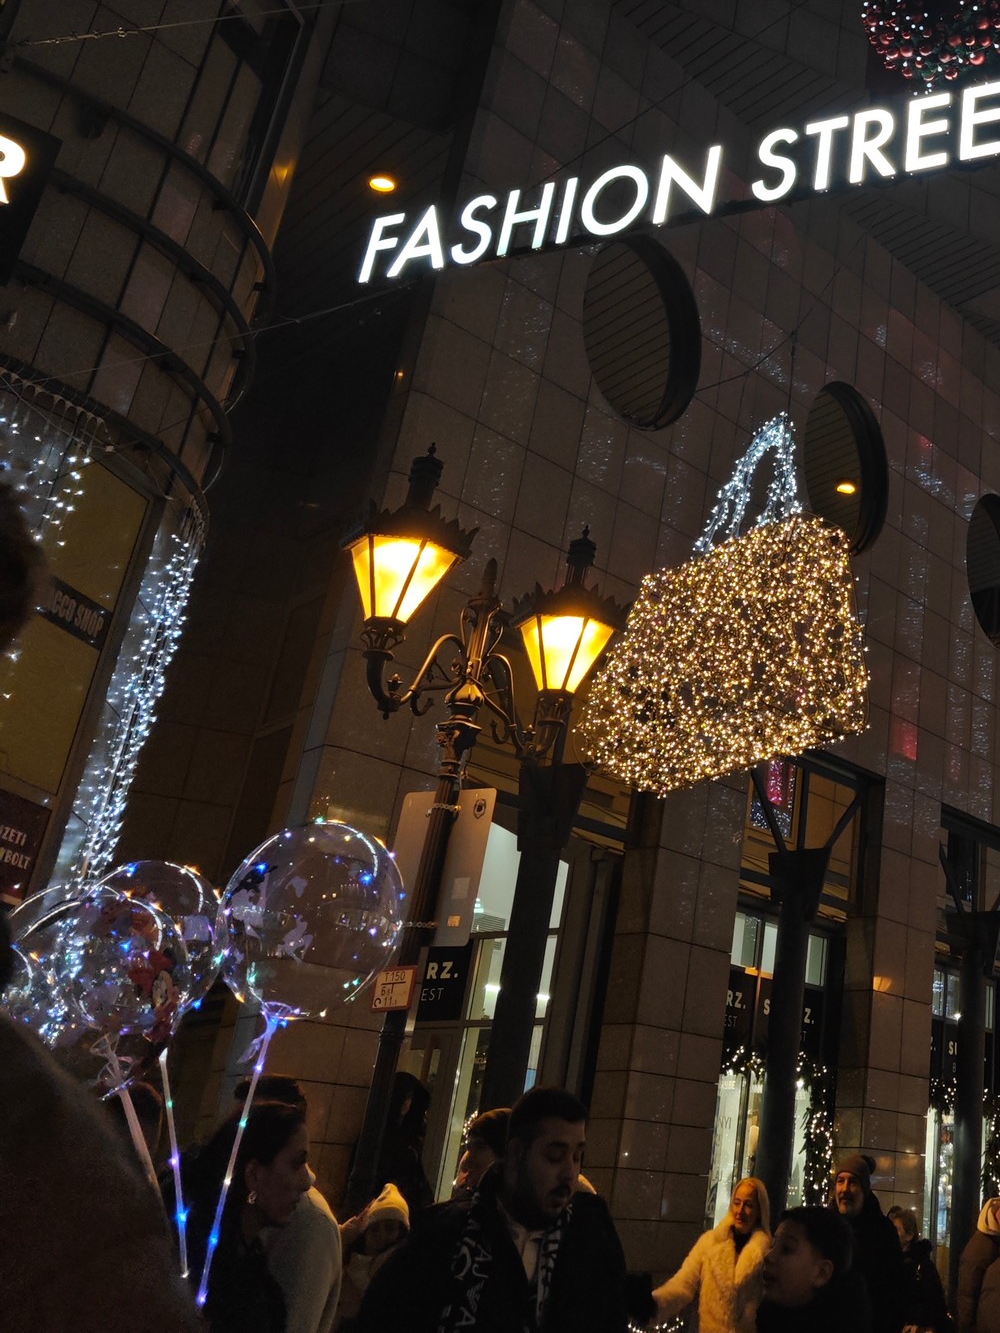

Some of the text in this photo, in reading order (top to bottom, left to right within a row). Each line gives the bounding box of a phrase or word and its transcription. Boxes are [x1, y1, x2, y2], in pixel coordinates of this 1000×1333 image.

[358, 144, 723, 284] FASHION
[0, 825, 28, 847] ZETI
[0, 847, 31, 870] BOLT
